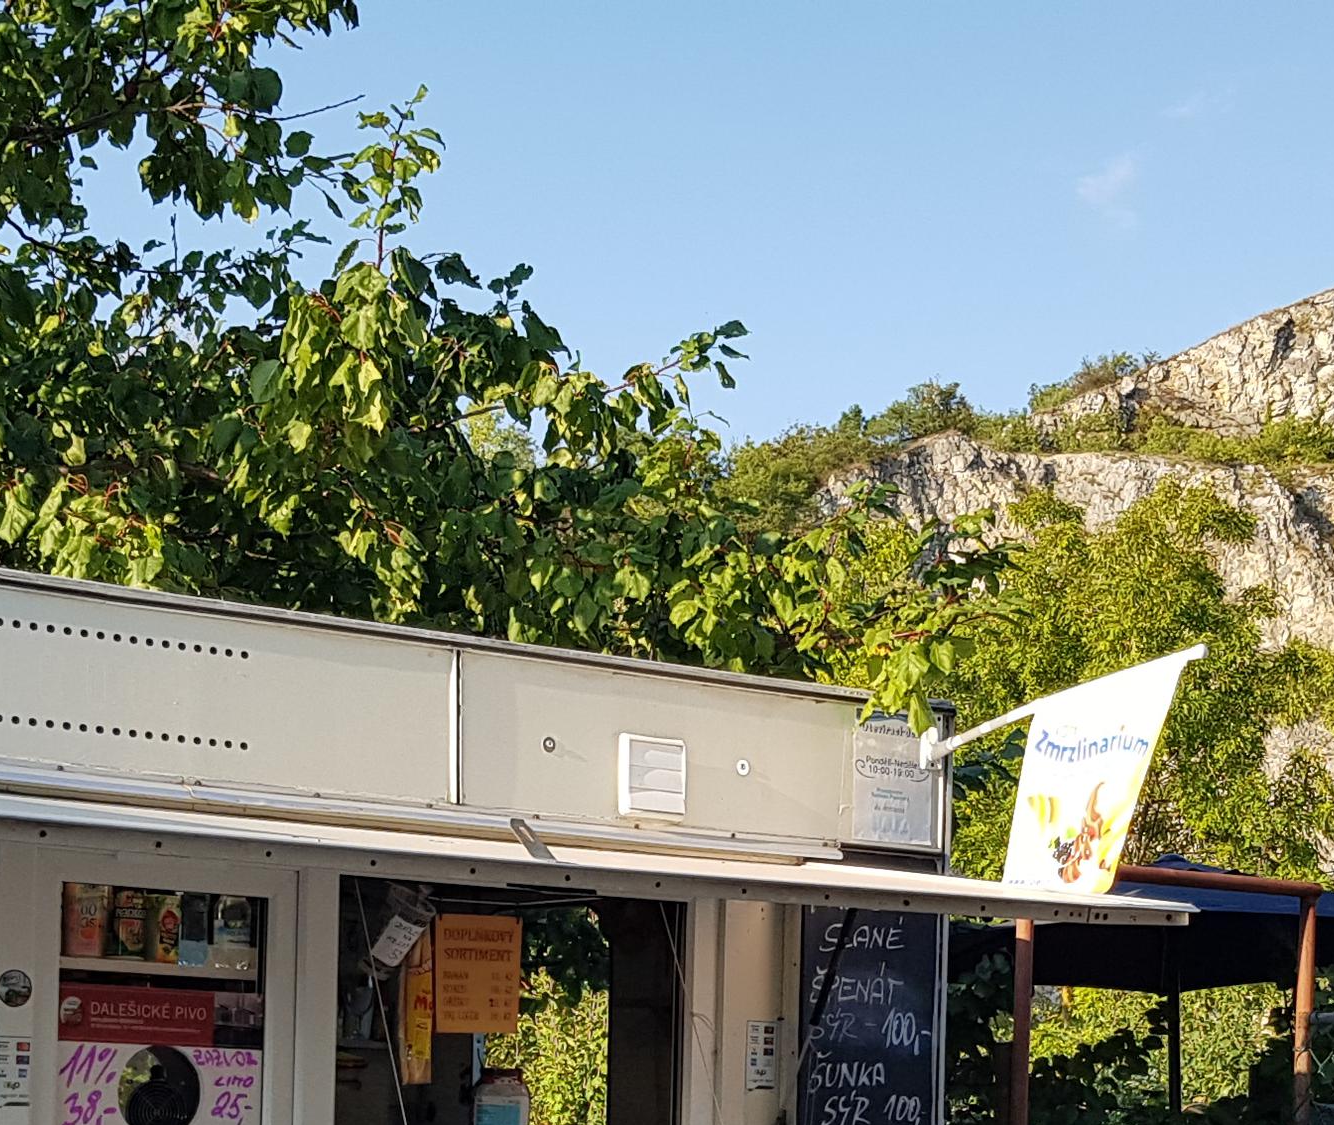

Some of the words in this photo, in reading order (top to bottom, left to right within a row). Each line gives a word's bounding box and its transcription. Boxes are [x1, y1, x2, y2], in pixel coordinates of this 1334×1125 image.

[89, 1000, 171, 1020] DALEŠICKÉ
[175, 1006, 208, 1022] PIVO
[59, 1044, 119, 1089] 11%
[214, 1075, 254, 1088] LIMO
[809, 1050, 886, 1093] ŠUNKA
